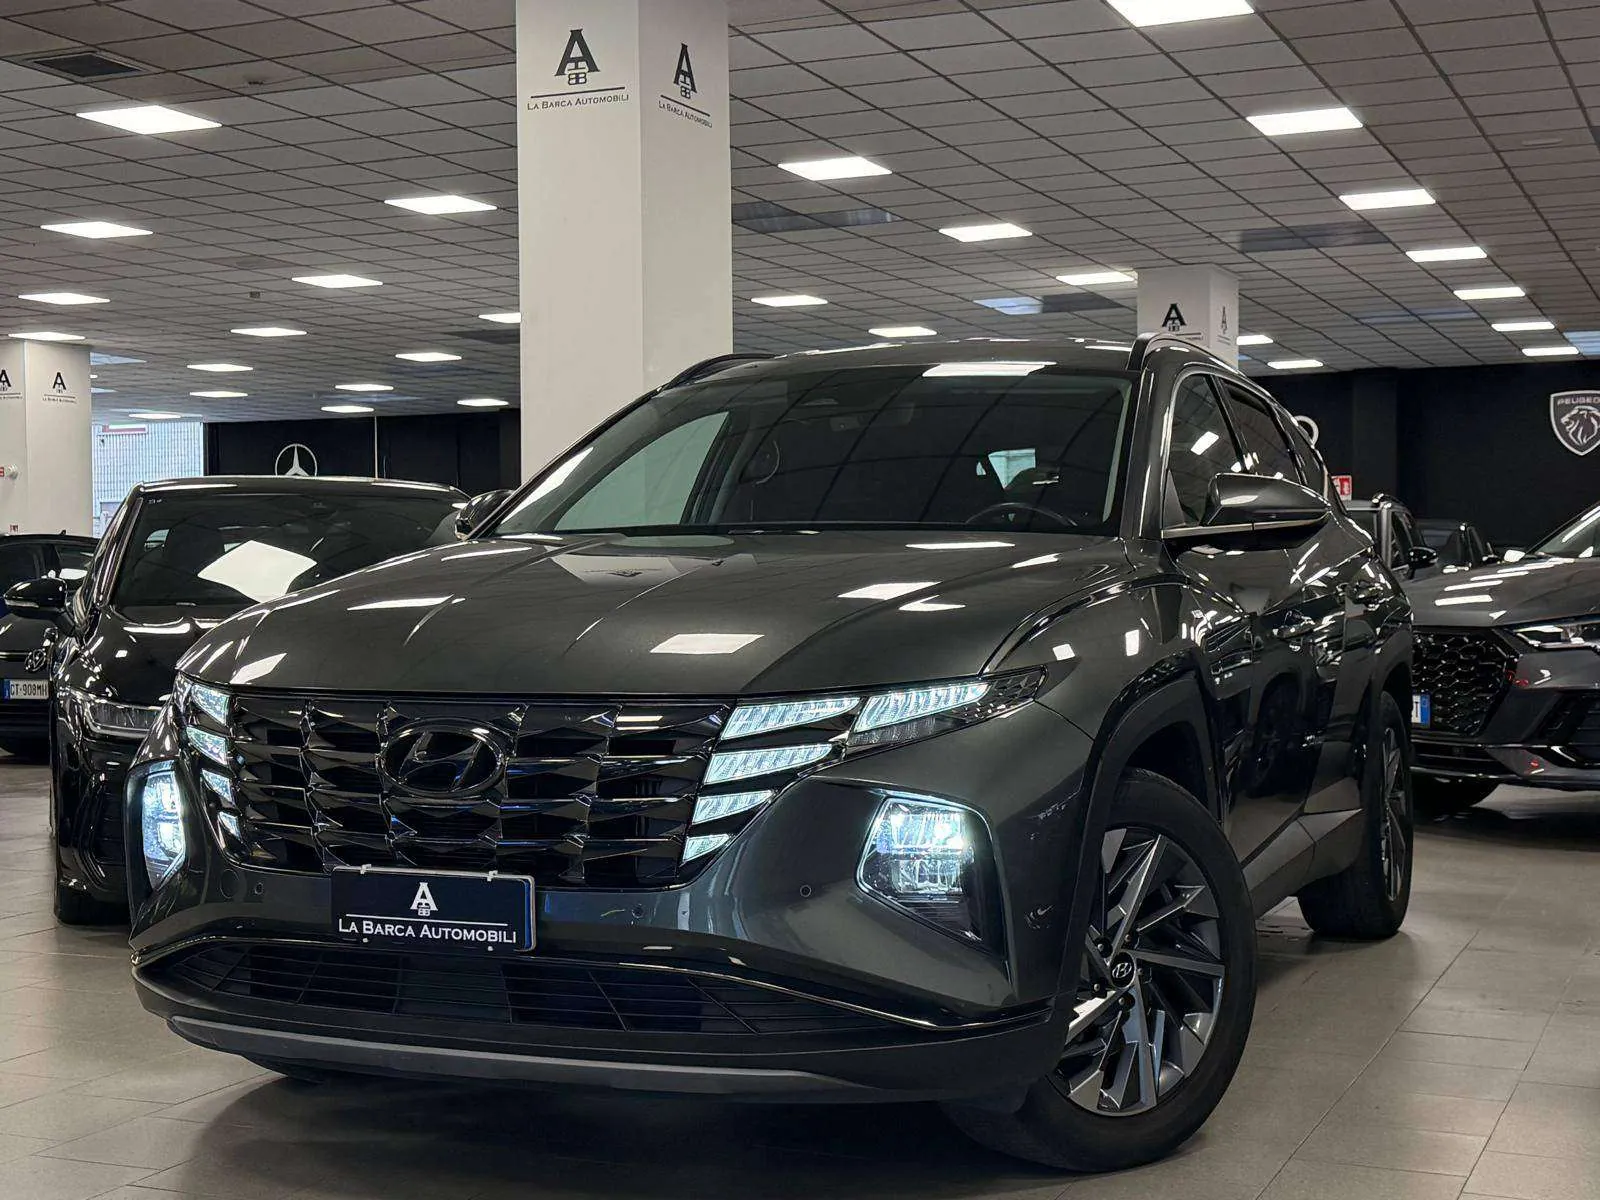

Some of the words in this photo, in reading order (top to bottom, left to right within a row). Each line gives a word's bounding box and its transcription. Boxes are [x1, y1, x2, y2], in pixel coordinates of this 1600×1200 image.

[542, 100, 573, 110] BARCA
[575, 94, 629, 106] AUTOMOBILI
[338, 918, 358, 934] LA
[362, 920, 416, 938] BARCA
[420, 923, 517, 944] AUTOMOBILI
